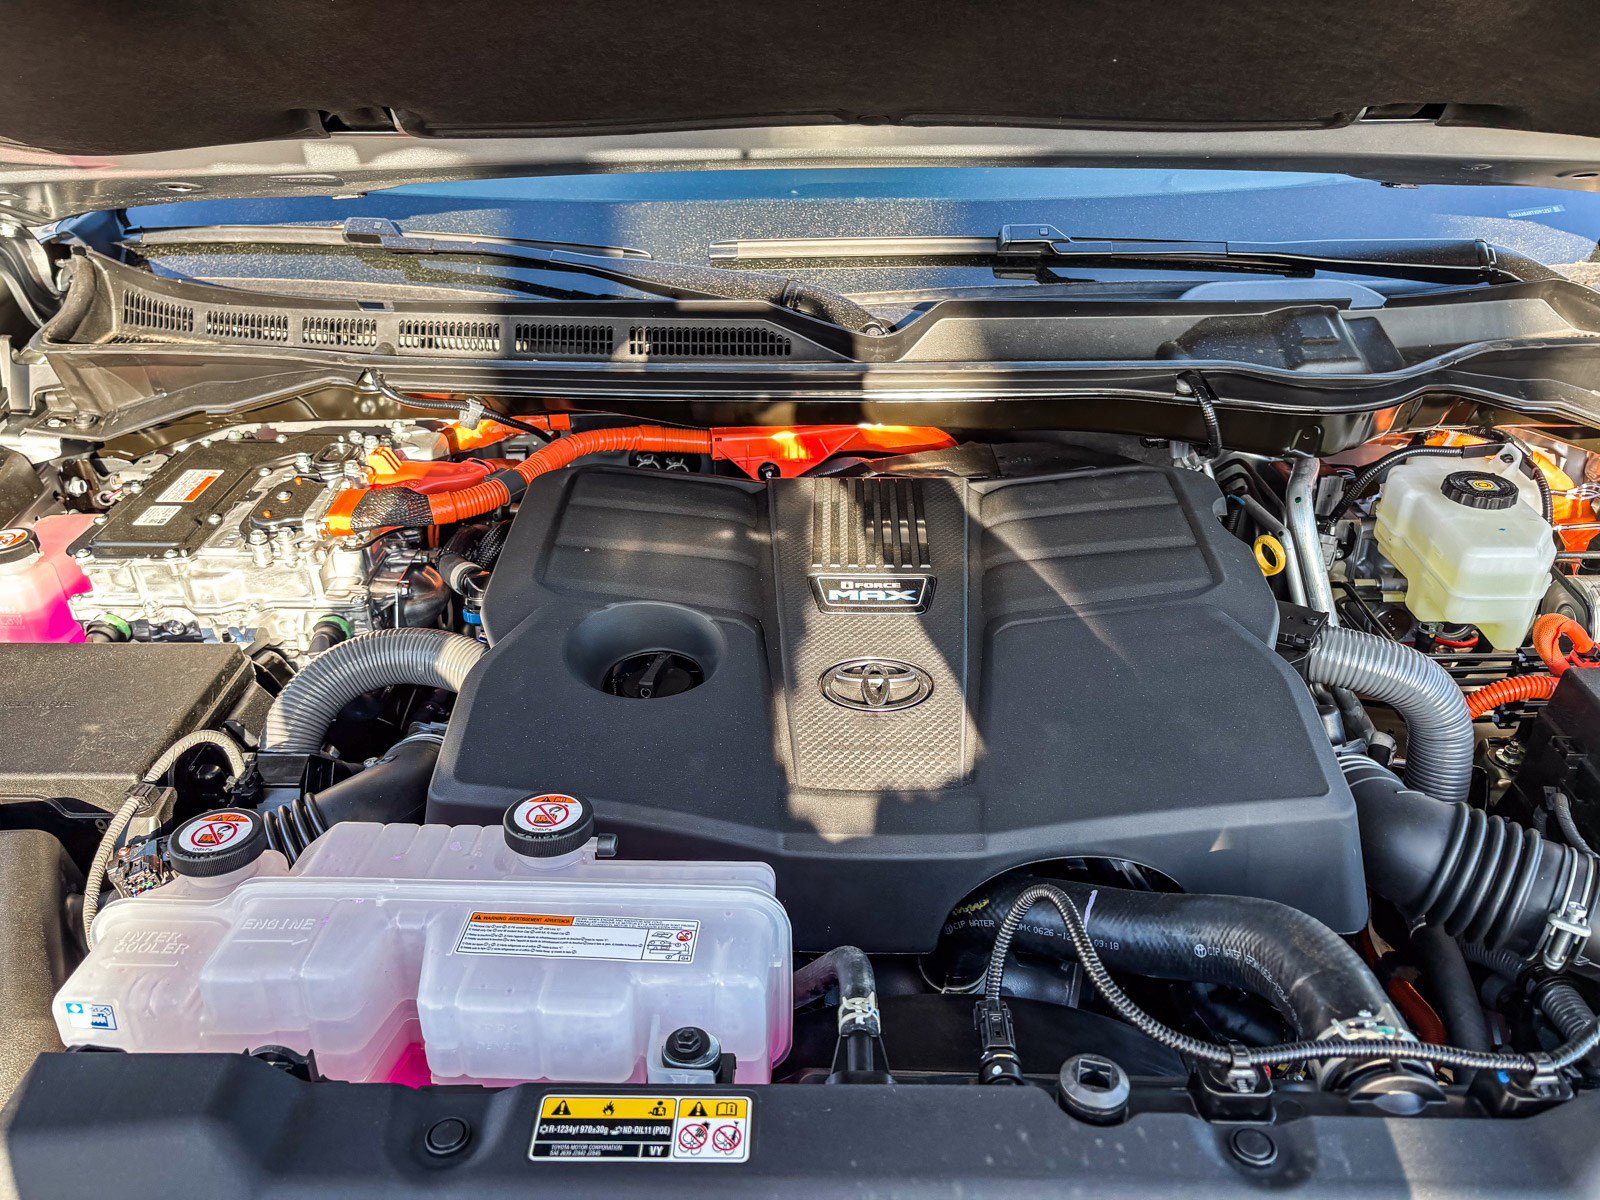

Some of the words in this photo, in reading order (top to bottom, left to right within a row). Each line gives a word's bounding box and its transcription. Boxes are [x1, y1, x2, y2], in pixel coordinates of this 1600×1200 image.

[828, 590, 917, 601] MAX
[240, 918, 316, 930] ENGINE
[119, 931, 182, 943] INTER
[969, 919, 995, 928] WATER
[1033, 927, 1054, 937] 0626
[1094, 939, 1120, 950] 09:18
[113, 942, 190, 954] COOLER
[549, 1125, 580, 1135] R-1234yf
[652, 1126, 671, 1136] (POE)
[649, 1145, 664, 1156] VY
